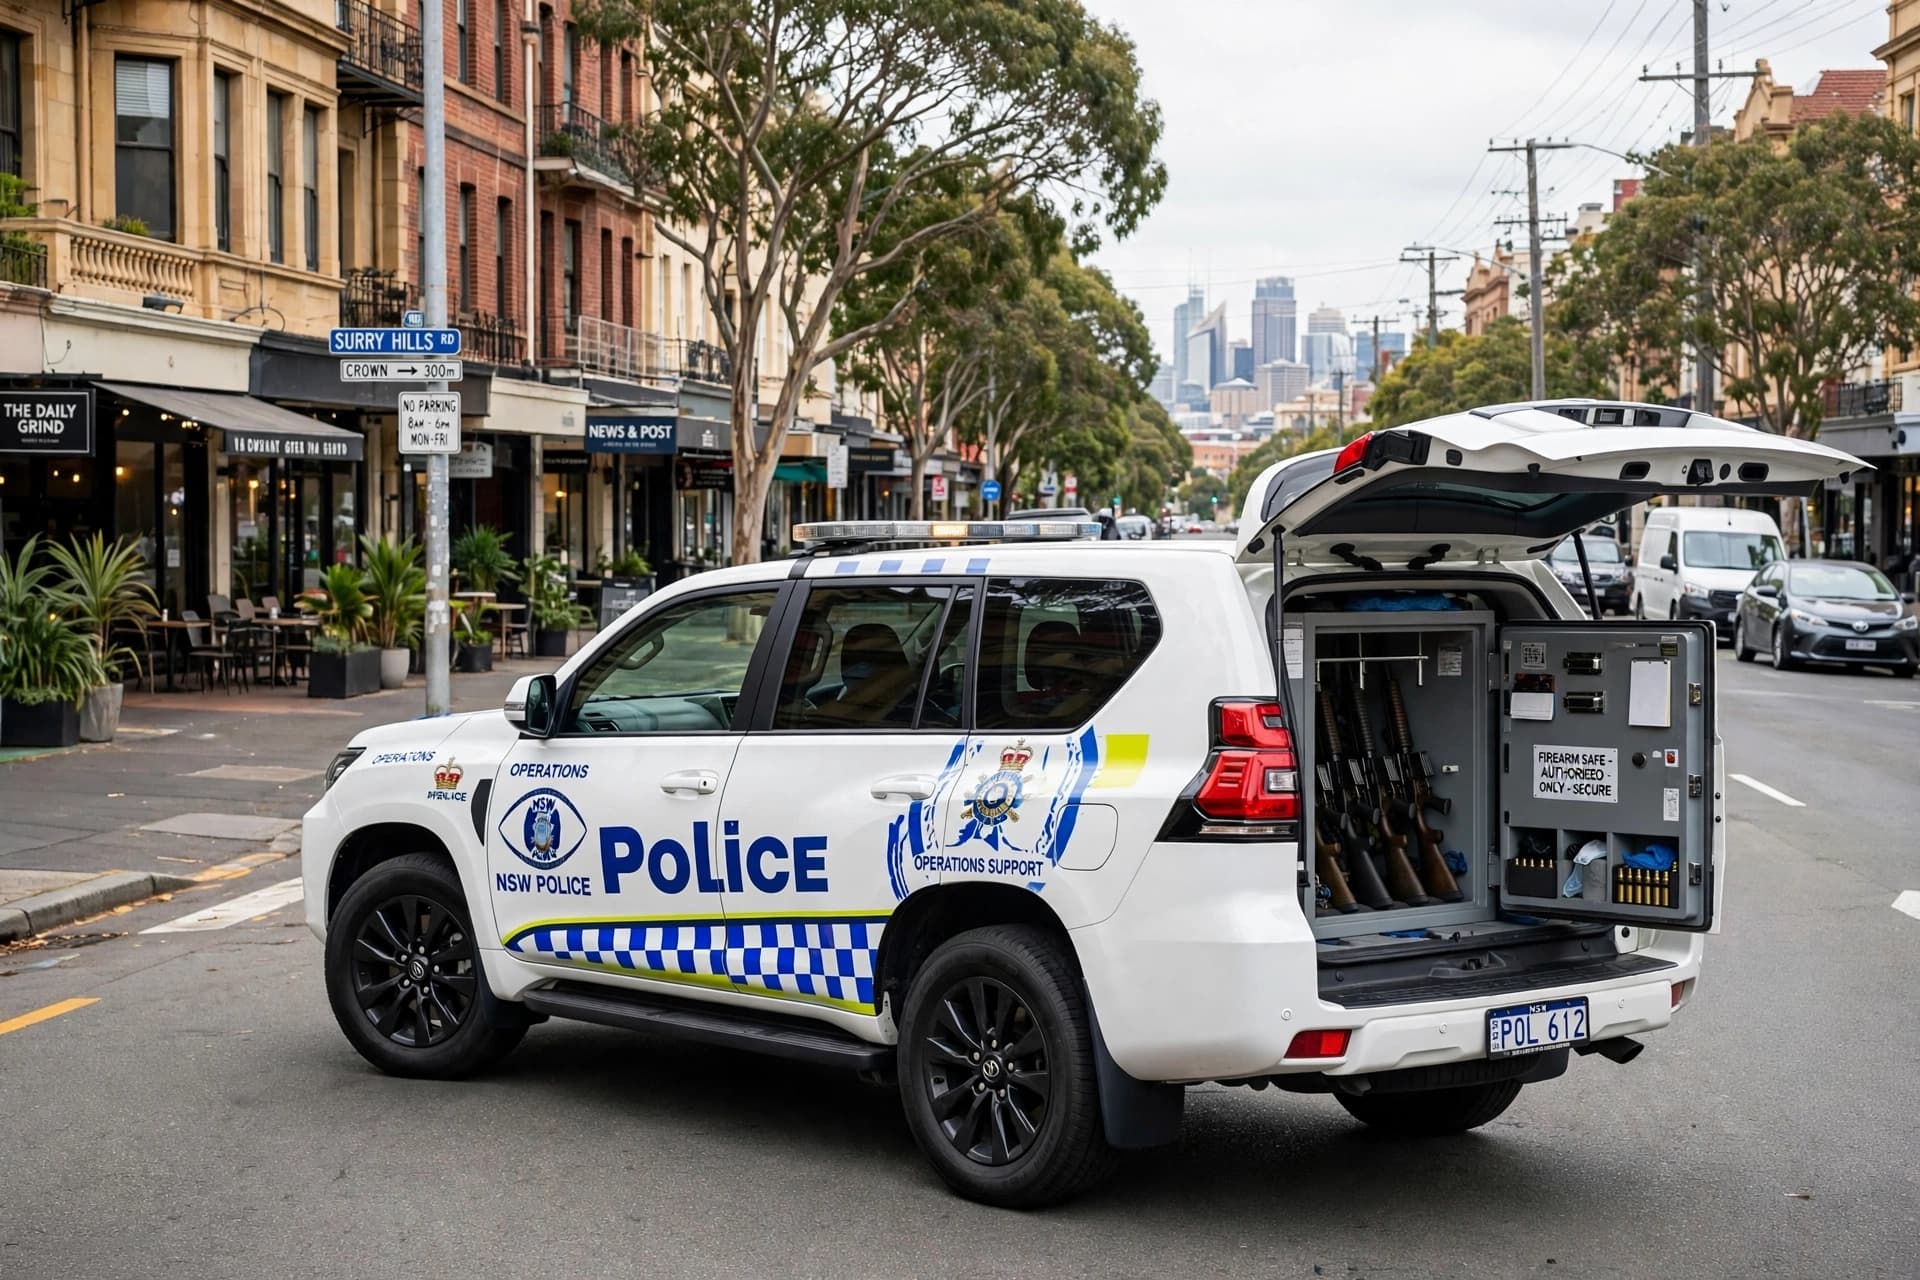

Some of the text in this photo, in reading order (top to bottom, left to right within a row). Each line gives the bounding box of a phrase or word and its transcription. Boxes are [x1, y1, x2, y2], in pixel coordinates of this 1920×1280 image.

[335, 332, 455, 350] SURRY HILLS RD
[346, 364, 455, 377] CROWN 300m
[3, 403, 77, 418] THE DAILY
[403, 400, 415, 412] NO
[17, 419, 65, 434] GRIND
[589, 425, 672, 439] NEWS & POST
[1538, 752, 1580, 764] FIREARM
[1582, 754, 1606, 766] SAFE
[510, 763, 589, 778] OPERATIONS
[1539, 781, 1565, 793] ONLY
[1573, 783, 1612, 796] SECURE
[532, 797, 556, 811] NSW
[914, 855, 1043, 876] OPERATIONS SUPPORT
[496, 873, 592, 896] NSW POLICE
[1501, 1015, 1539, 1049] POL
[1548, 1009, 1585, 1041] 612
